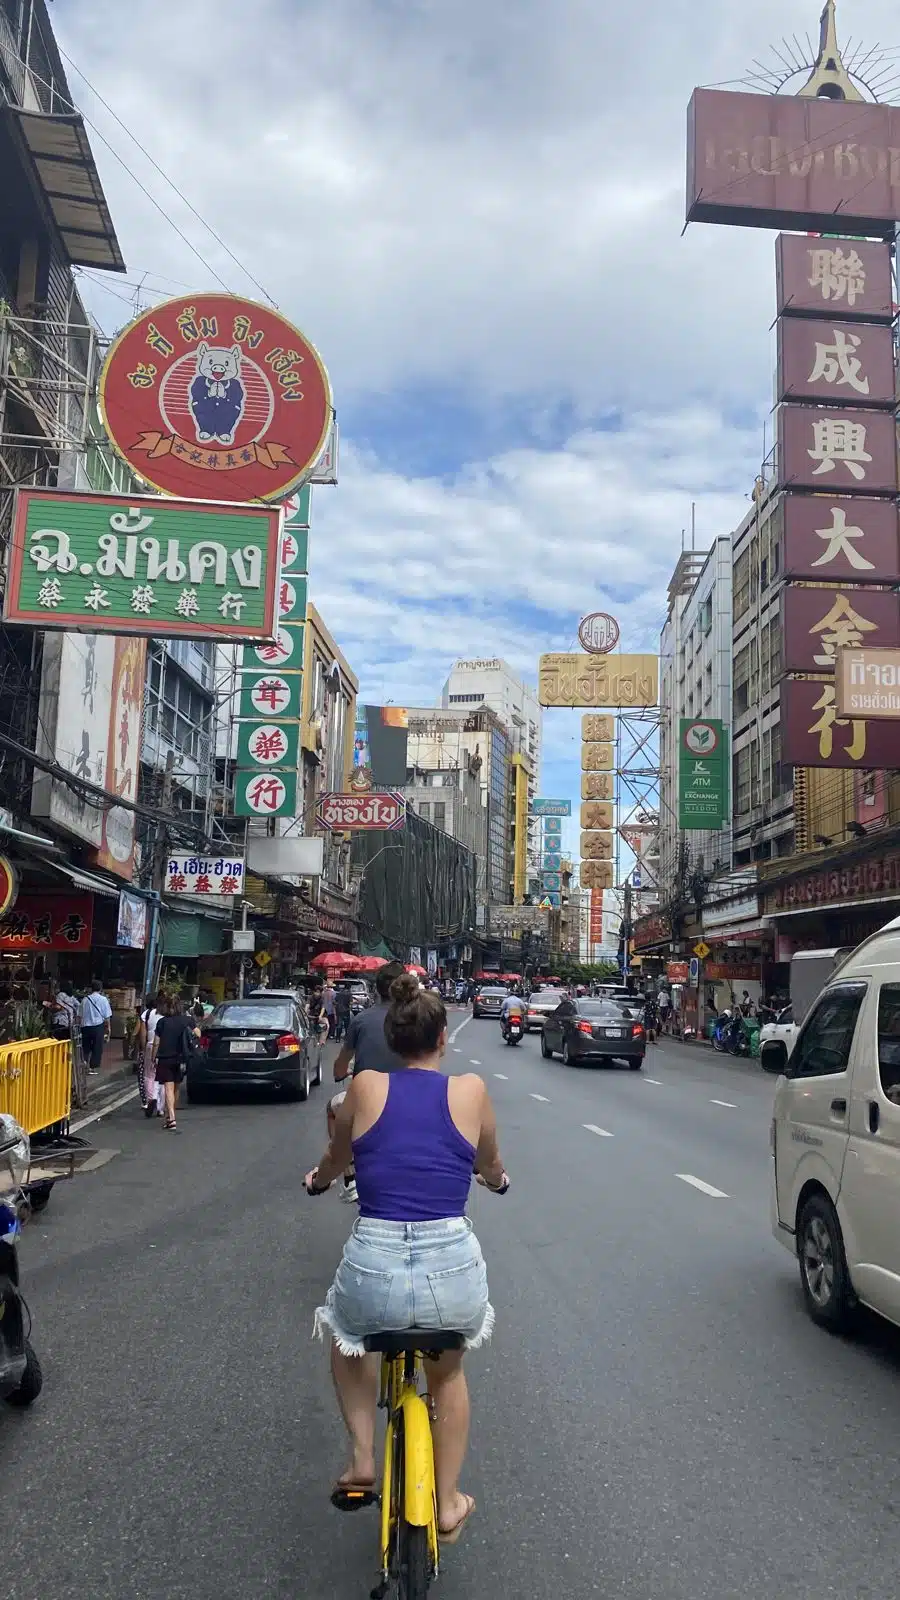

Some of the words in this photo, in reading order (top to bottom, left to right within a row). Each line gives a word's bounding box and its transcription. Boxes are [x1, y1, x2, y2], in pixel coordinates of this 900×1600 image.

[806, 247, 879, 760] 聯成興大金行
[29, 507, 262, 589] ฉ.มั่นคง
[36, 577, 248, 621] 蔡永發藥行
[850, 653, 900, 686] ที่จอ
[692, 778, 711, 786] ATM
[168, 873, 239, 894] 蔡益發
